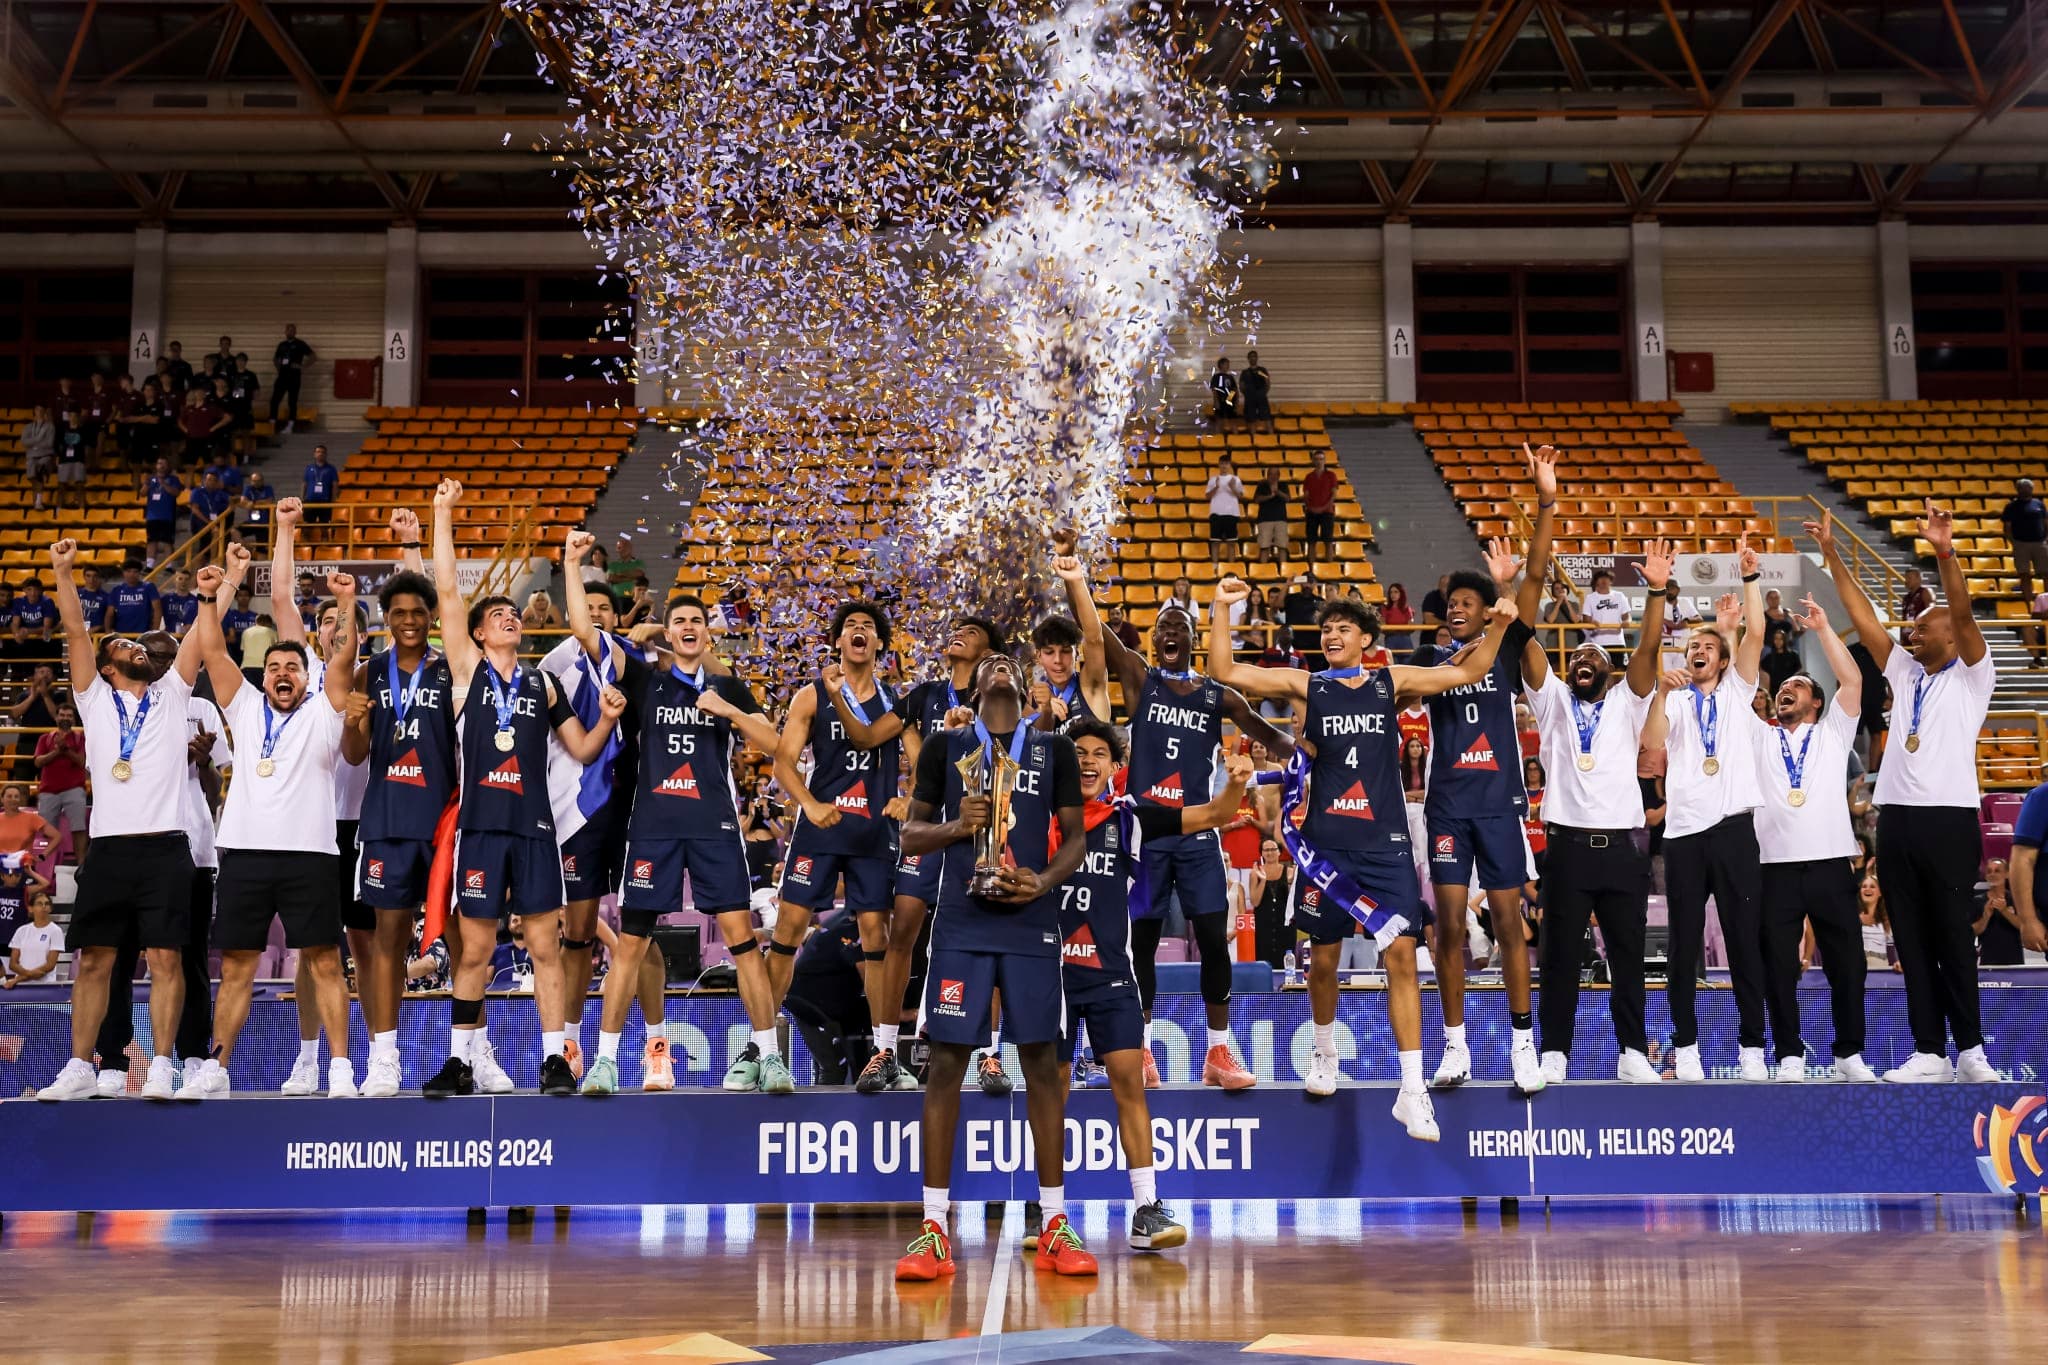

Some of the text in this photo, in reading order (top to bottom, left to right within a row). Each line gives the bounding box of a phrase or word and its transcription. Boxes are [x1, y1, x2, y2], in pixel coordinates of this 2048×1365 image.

[138, 332, 148, 345] A
[392, 332, 402, 345] A
[1395, 328, 1406, 341] A
[1646, 327, 1657, 339] A
[1895, 326, 1906, 339] A
[134, 347, 152, 360] 14
[388, 346, 406, 360] 13
[641, 347, 658, 360] 13
[1393, 343, 1408, 355] 11
[1644, 341, 1660, 354] 11
[1893, 341, 1910, 354] 10
[1558, 557, 1614, 568] HERAKLION
[1564, 568, 1592, 578] RENA
[119, 592, 144, 602] ITALIA
[80, 598, 100, 610] TALIA
[22, 610, 42, 623] ITALIA
[656, 706, 715, 727] FRANCE
[1148, 702, 1210, 733] FRANCE
[1466, 703, 1479, 724] 0
[394, 718, 420, 740] 34
[1322, 714, 1385, 736] FRANCE
[668, 734, 696, 754] 55
[1166, 737, 1180, 760] 5
[845, 750, 870, 770] 32
[1345, 747, 1358, 768] 4
[1460, 750, 1494, 764] MAIF
[388, 766, 422, 777] MAIF
[488, 772, 522, 784] MAIF
[662, 778, 696, 790] MAIF
[1151, 785, 1184, 800] MAIF
[836, 796, 868, 808] MAIF
[1334, 798, 1369, 810] MAIF
[1076, 851, 1116, 876] NCE
[1061, 885, 1092, 911] 79
[0, 906, 14, 920] 32
[1236, 916, 1245, 930] 5
[1062, 944, 1096, 958] MAIF
[758, 1118, 1260, 1174] FIBA U1 EUOBSKET
[1468, 1128, 1736, 1159] HERAKLION, HELLAS 2024
[286, 1138, 554, 1172] HERAKLION, HELLAS 2024
